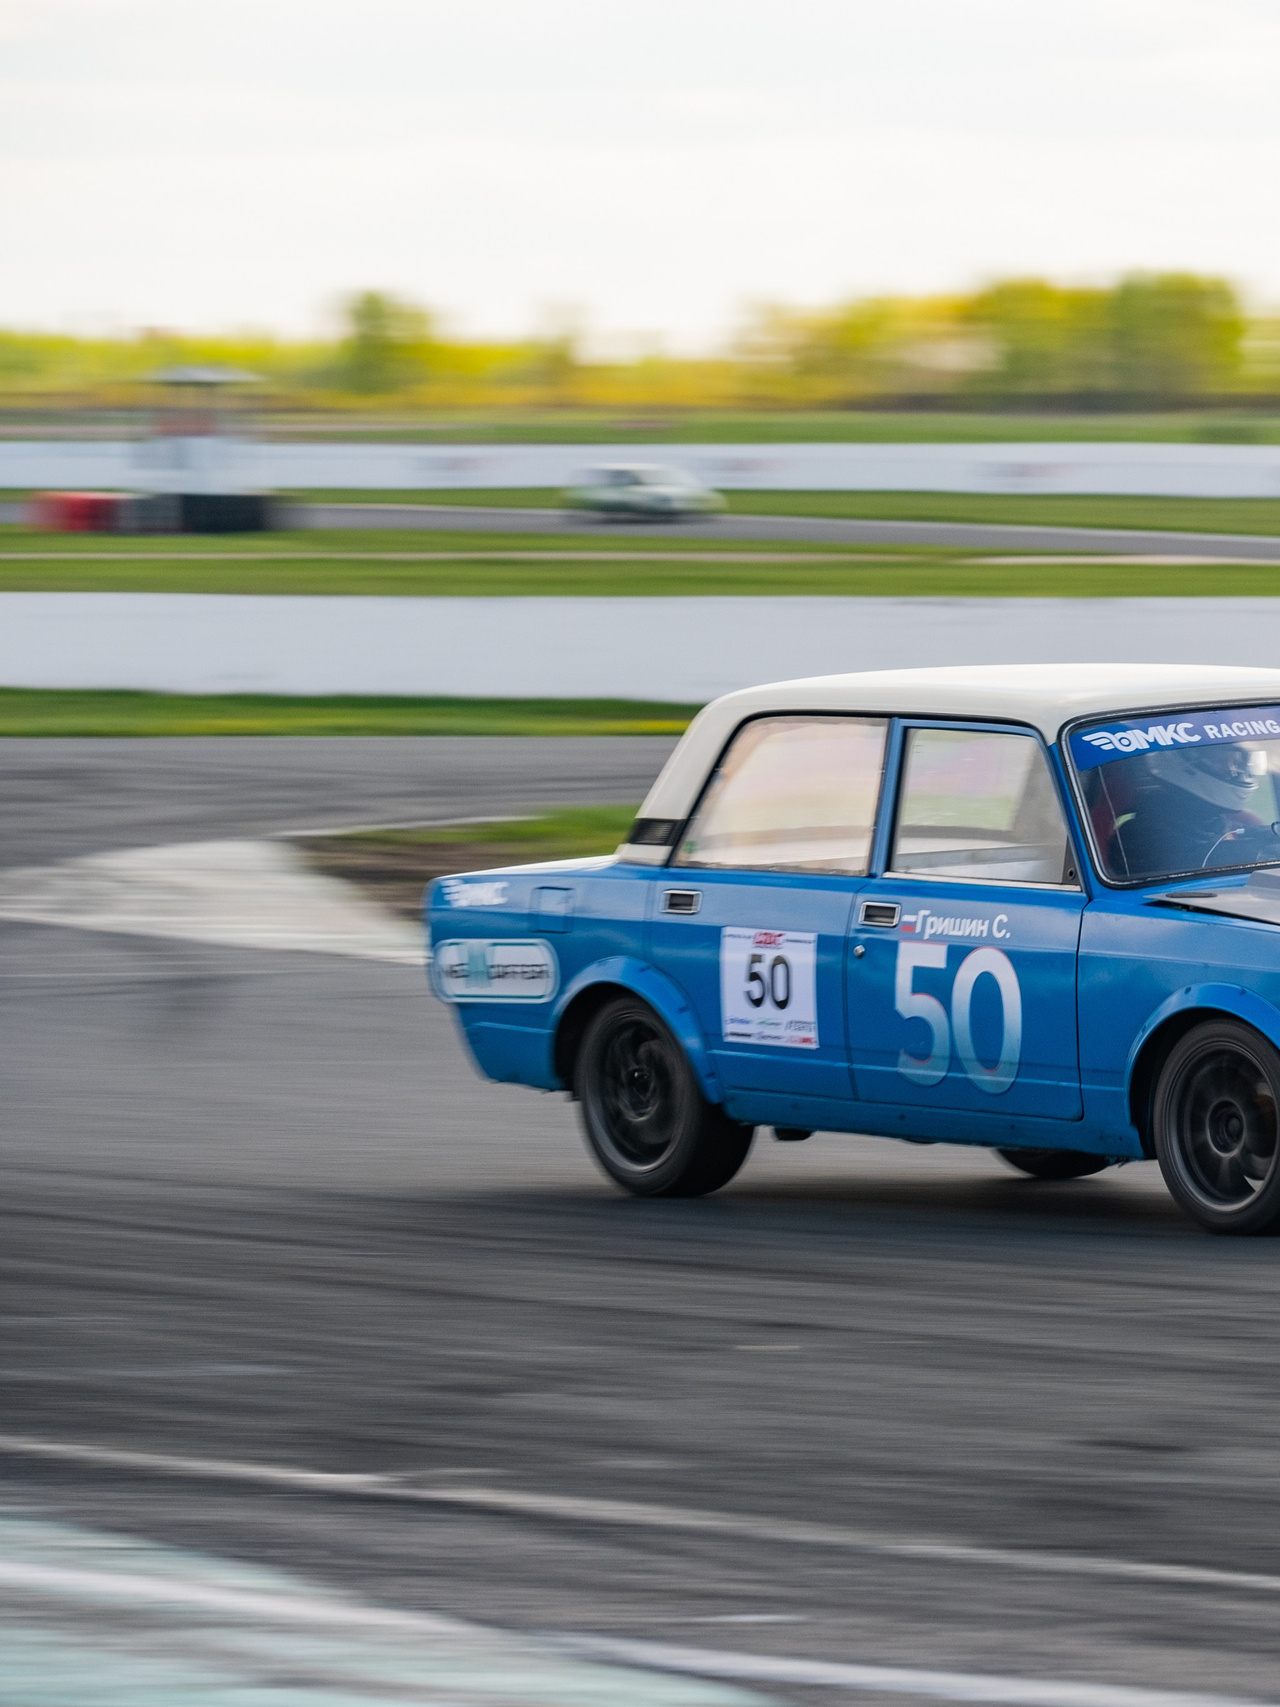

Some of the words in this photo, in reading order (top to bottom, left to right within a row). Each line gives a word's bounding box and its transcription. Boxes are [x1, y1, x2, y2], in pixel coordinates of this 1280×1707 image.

[914, 909, 989, 940] Гришин
[744, 953, 792, 1011] 50
[894, 939, 1023, 1096] 50
